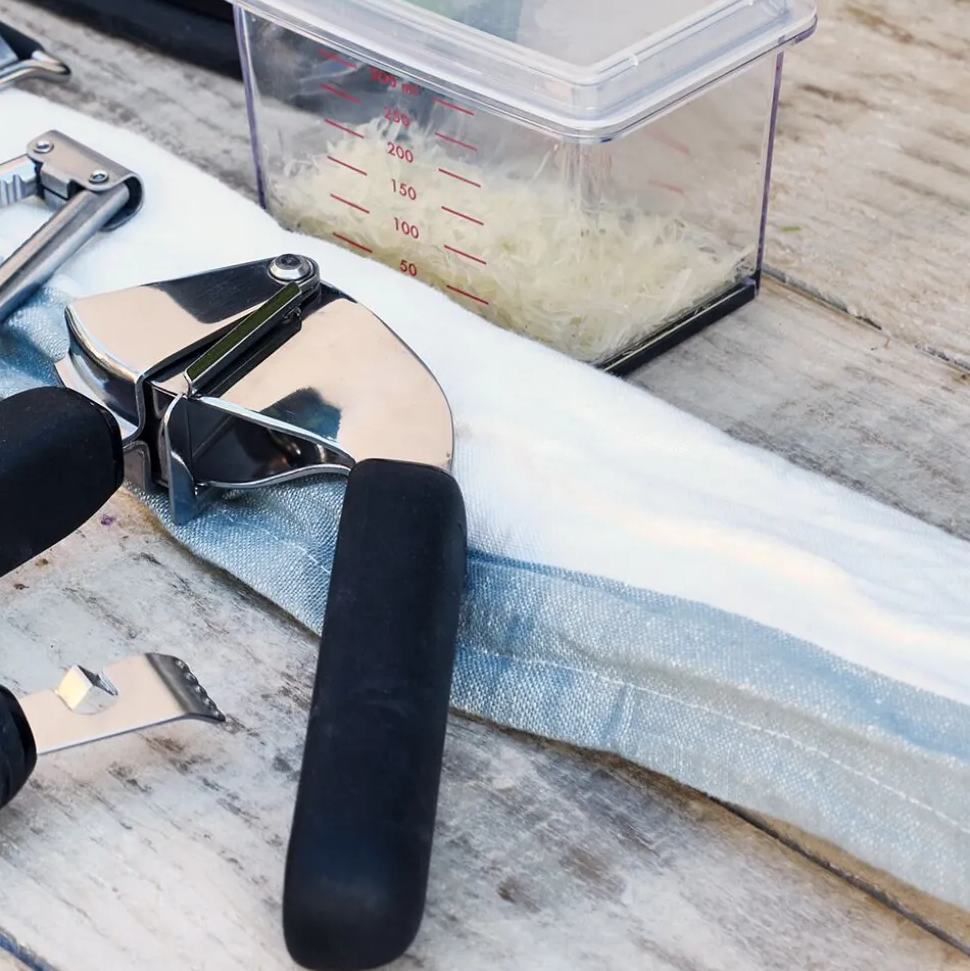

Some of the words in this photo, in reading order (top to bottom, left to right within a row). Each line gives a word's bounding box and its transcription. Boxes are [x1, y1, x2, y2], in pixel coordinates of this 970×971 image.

[383, 105, 411, 130] 250
[387, 141, 414, 163] 200
[391, 178, 417, 201] 150
[394, 216, 419, 239] 100
[400, 259, 417, 277] 50
